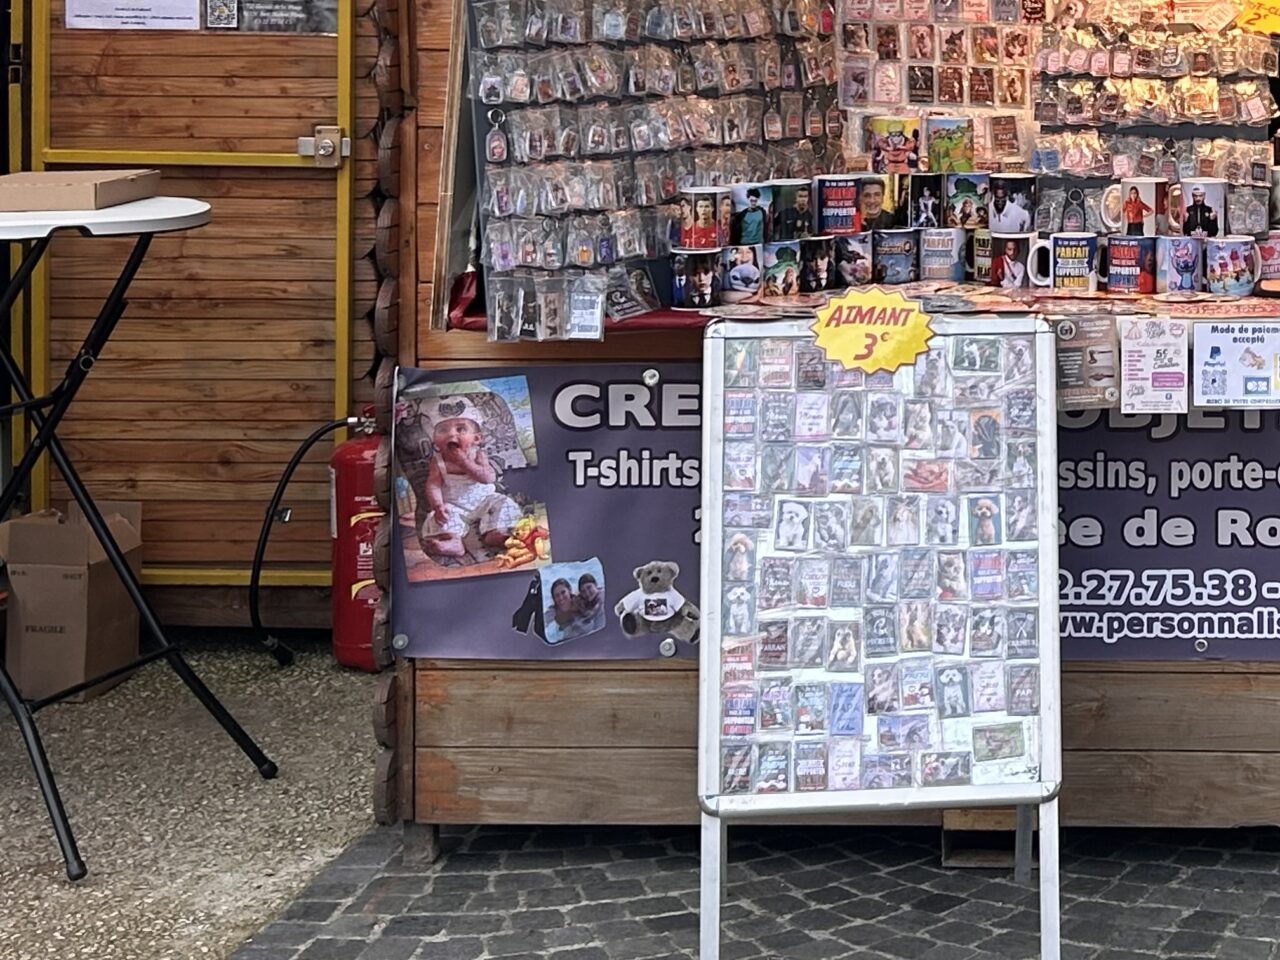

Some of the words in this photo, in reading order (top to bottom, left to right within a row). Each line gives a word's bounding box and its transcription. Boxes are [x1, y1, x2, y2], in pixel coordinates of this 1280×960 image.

[1056, 246, 1089, 258] PARFAIT
[825, 305, 915, 328] AIMANT
[1211, 325, 1235, 334] Mode
[1238, 325, 1250, 334] de
[554, 383, 701, 428] CRE
[568, 450, 701, 487] T-shirts
[1058, 451, 1156, 494] ssins,
[1123, 509, 1195, 547] de
[25, 625, 65, 634] FRAGILE
